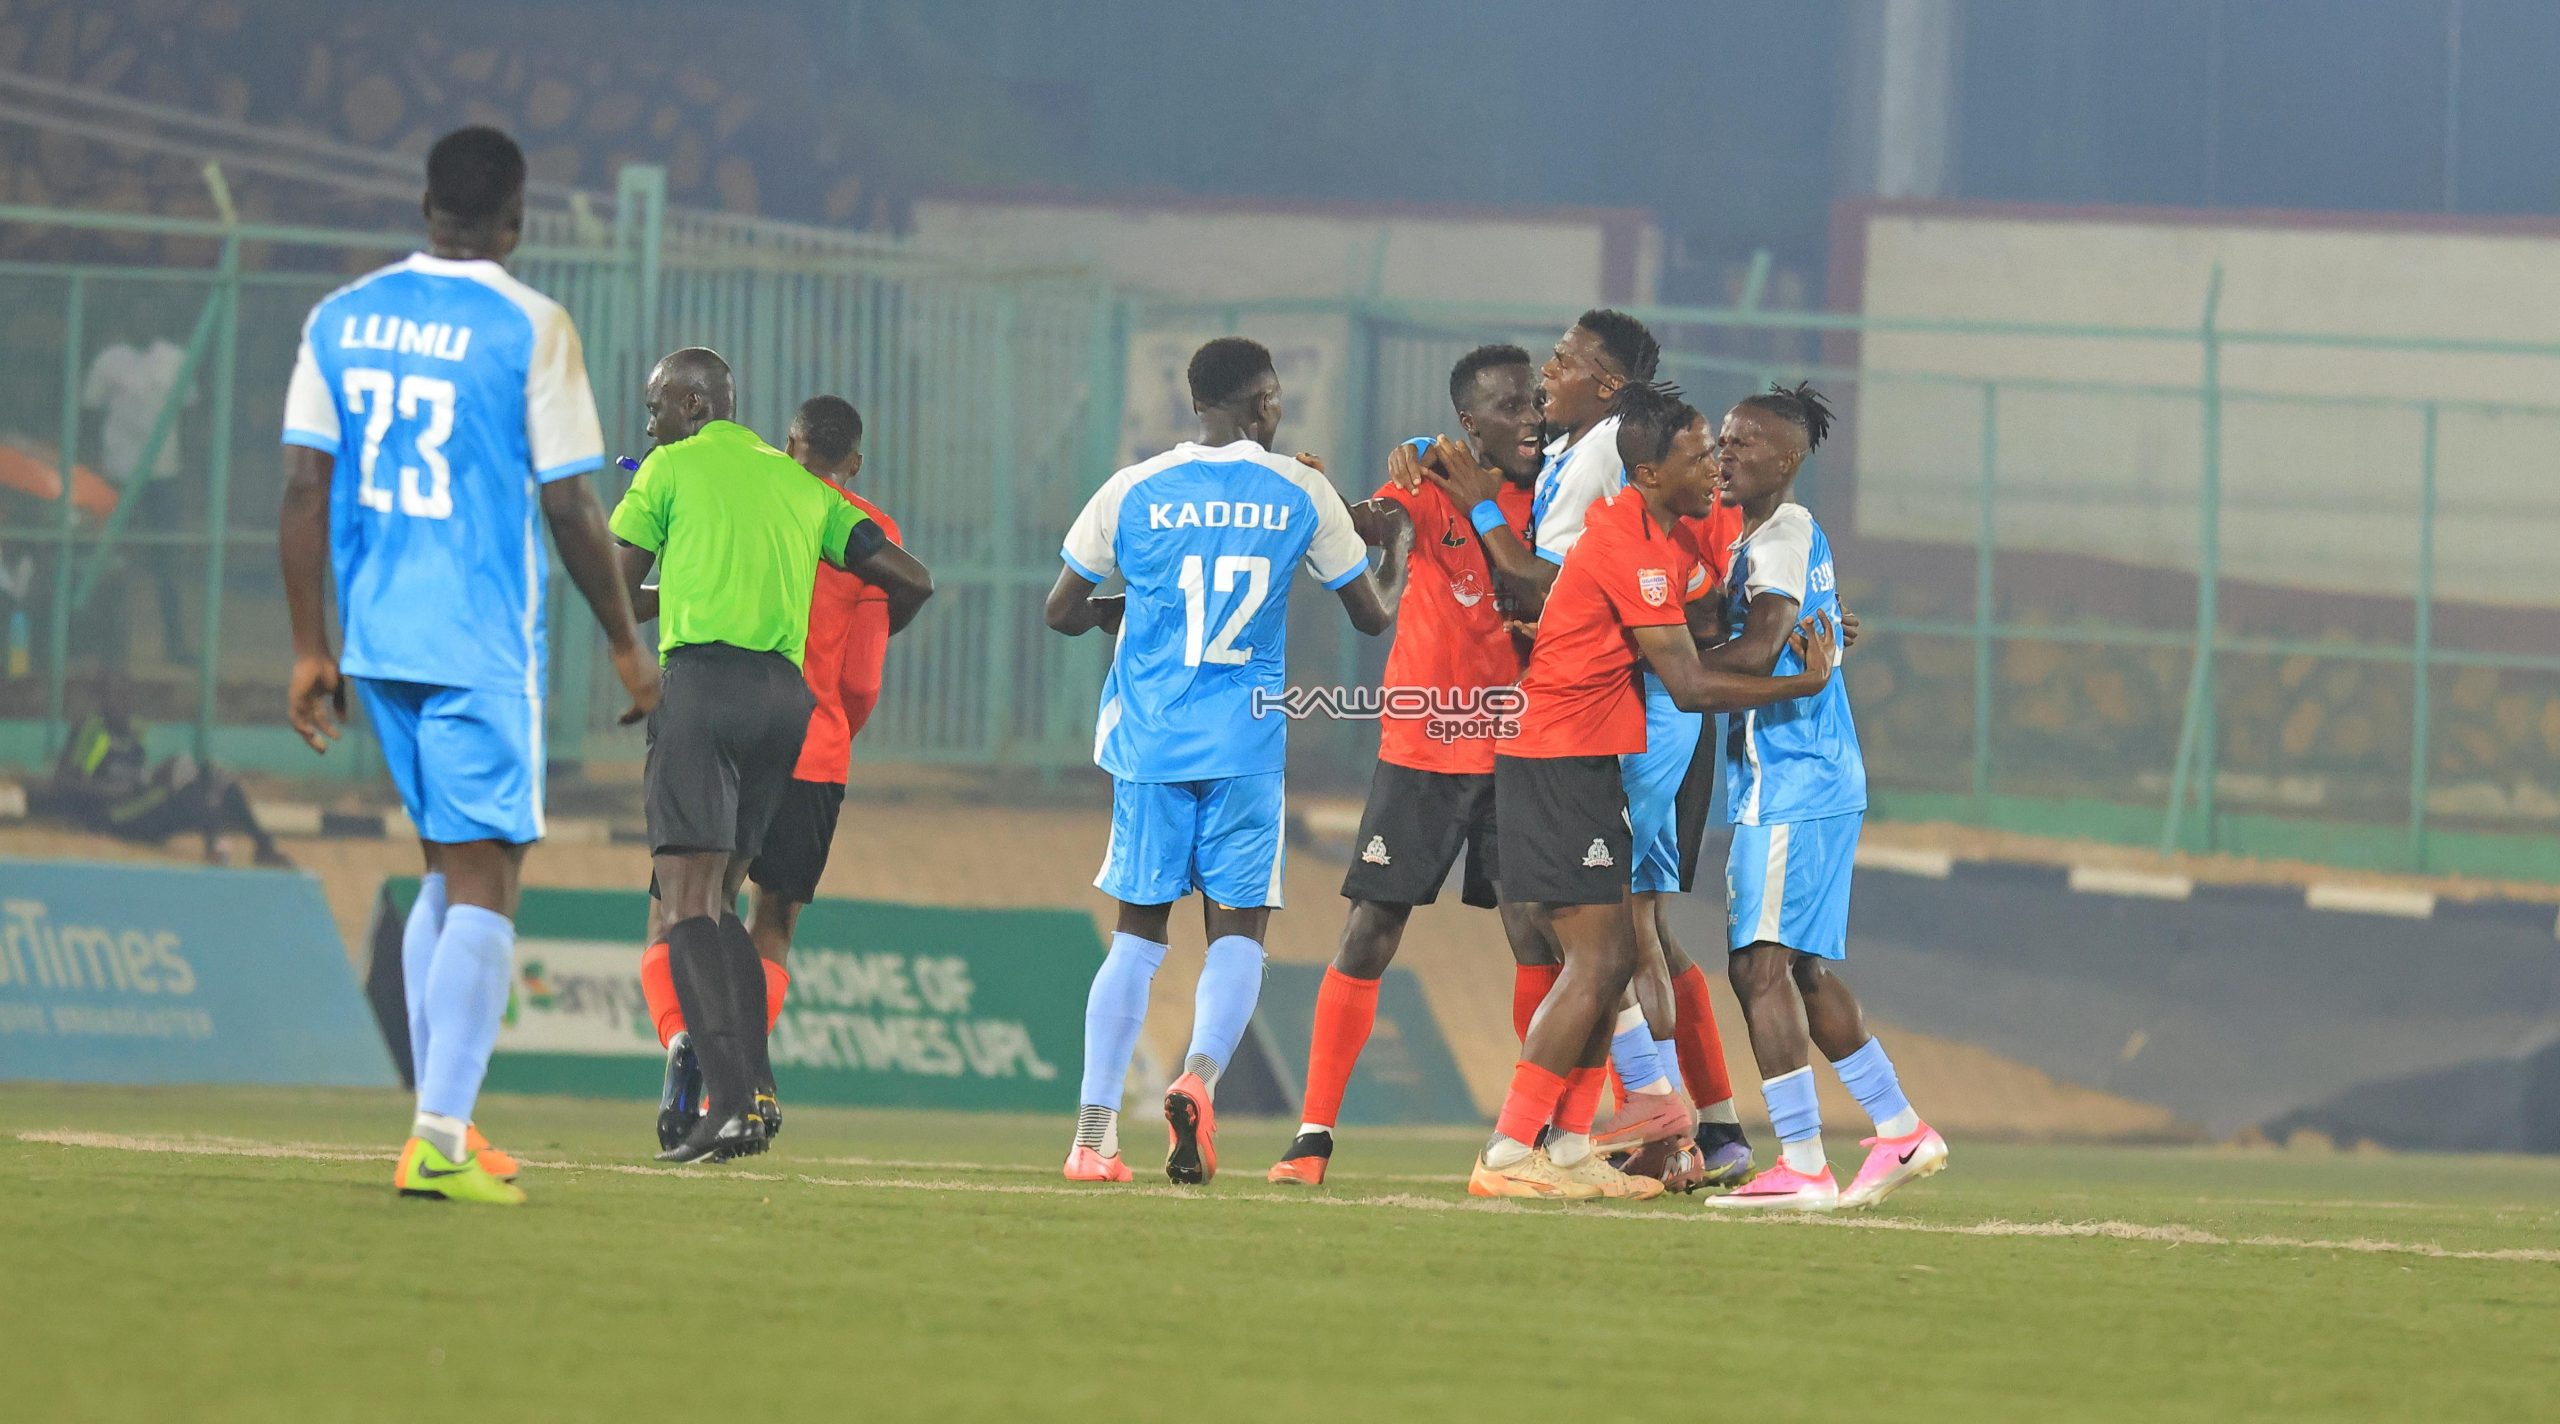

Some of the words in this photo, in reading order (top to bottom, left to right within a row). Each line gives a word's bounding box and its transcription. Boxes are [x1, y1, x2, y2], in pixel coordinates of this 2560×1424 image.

[340, 313, 472, 362] LUMU
[342, 366, 456, 520] 23
[1149, 501, 1290, 531] KADDU
[1177, 555, 1271, 667] 12
[912, 952, 976, 1015] OF
[766, 1010, 965, 1078] ARTIMES
[955, 1017, 1058, 1082] UPL
